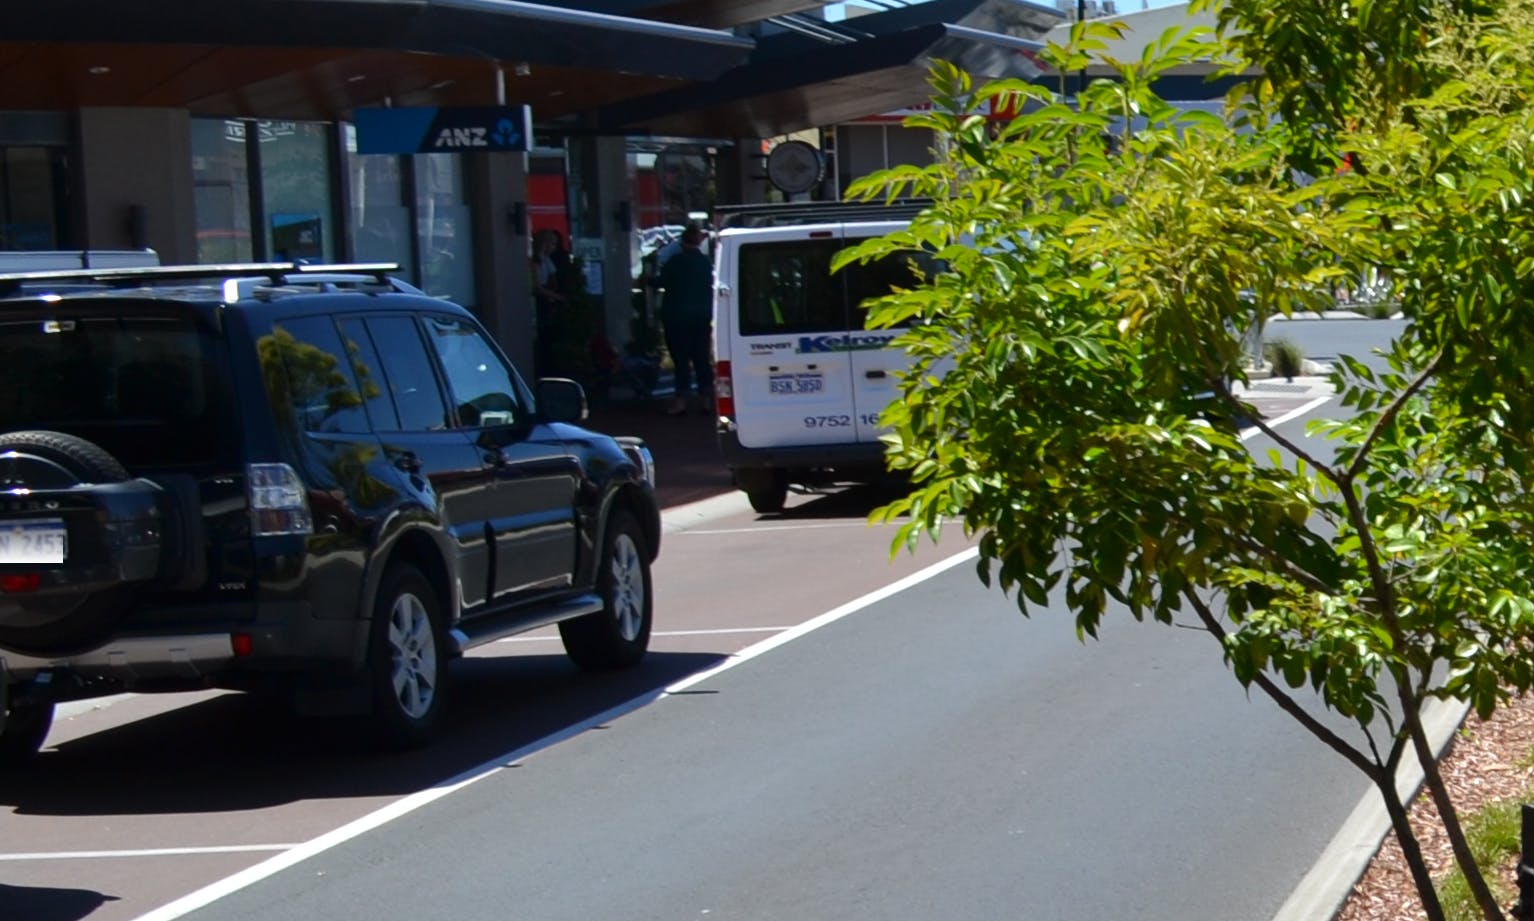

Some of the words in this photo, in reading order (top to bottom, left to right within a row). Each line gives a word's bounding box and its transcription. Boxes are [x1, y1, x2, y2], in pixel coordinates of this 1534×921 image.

[435, 127, 488, 147] ANZ
[750, 342, 792, 352] TRANSIT
[803, 414, 851, 429] 9752
